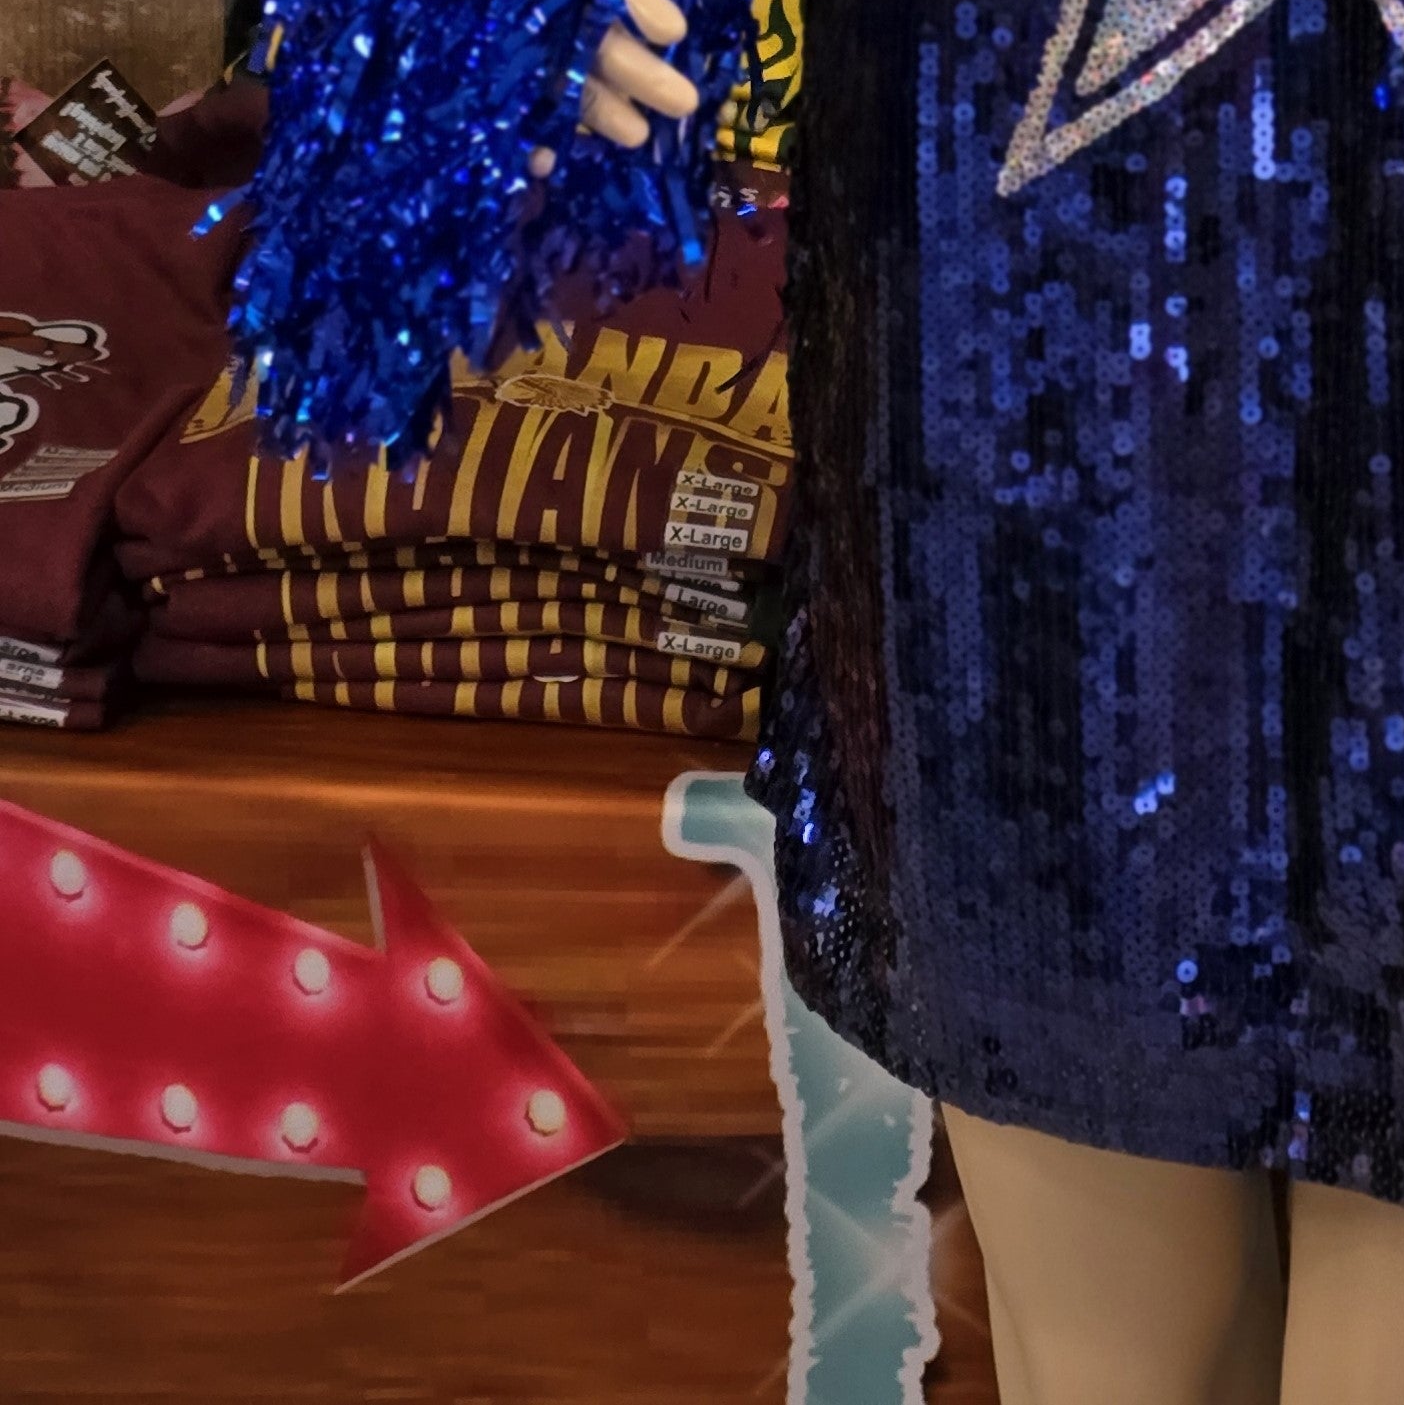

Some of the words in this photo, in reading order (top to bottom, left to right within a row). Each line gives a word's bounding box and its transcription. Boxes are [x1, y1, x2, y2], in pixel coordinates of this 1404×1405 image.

[682, 474, 754, 495] X-Large
[675, 496, 748, 517] X-Large
[669, 526, 743, 549] X-Large
[650, 553, 724, 573] Medium
[677, 588, 730, 616] Large
[663, 635, 736, 660] X-Large
